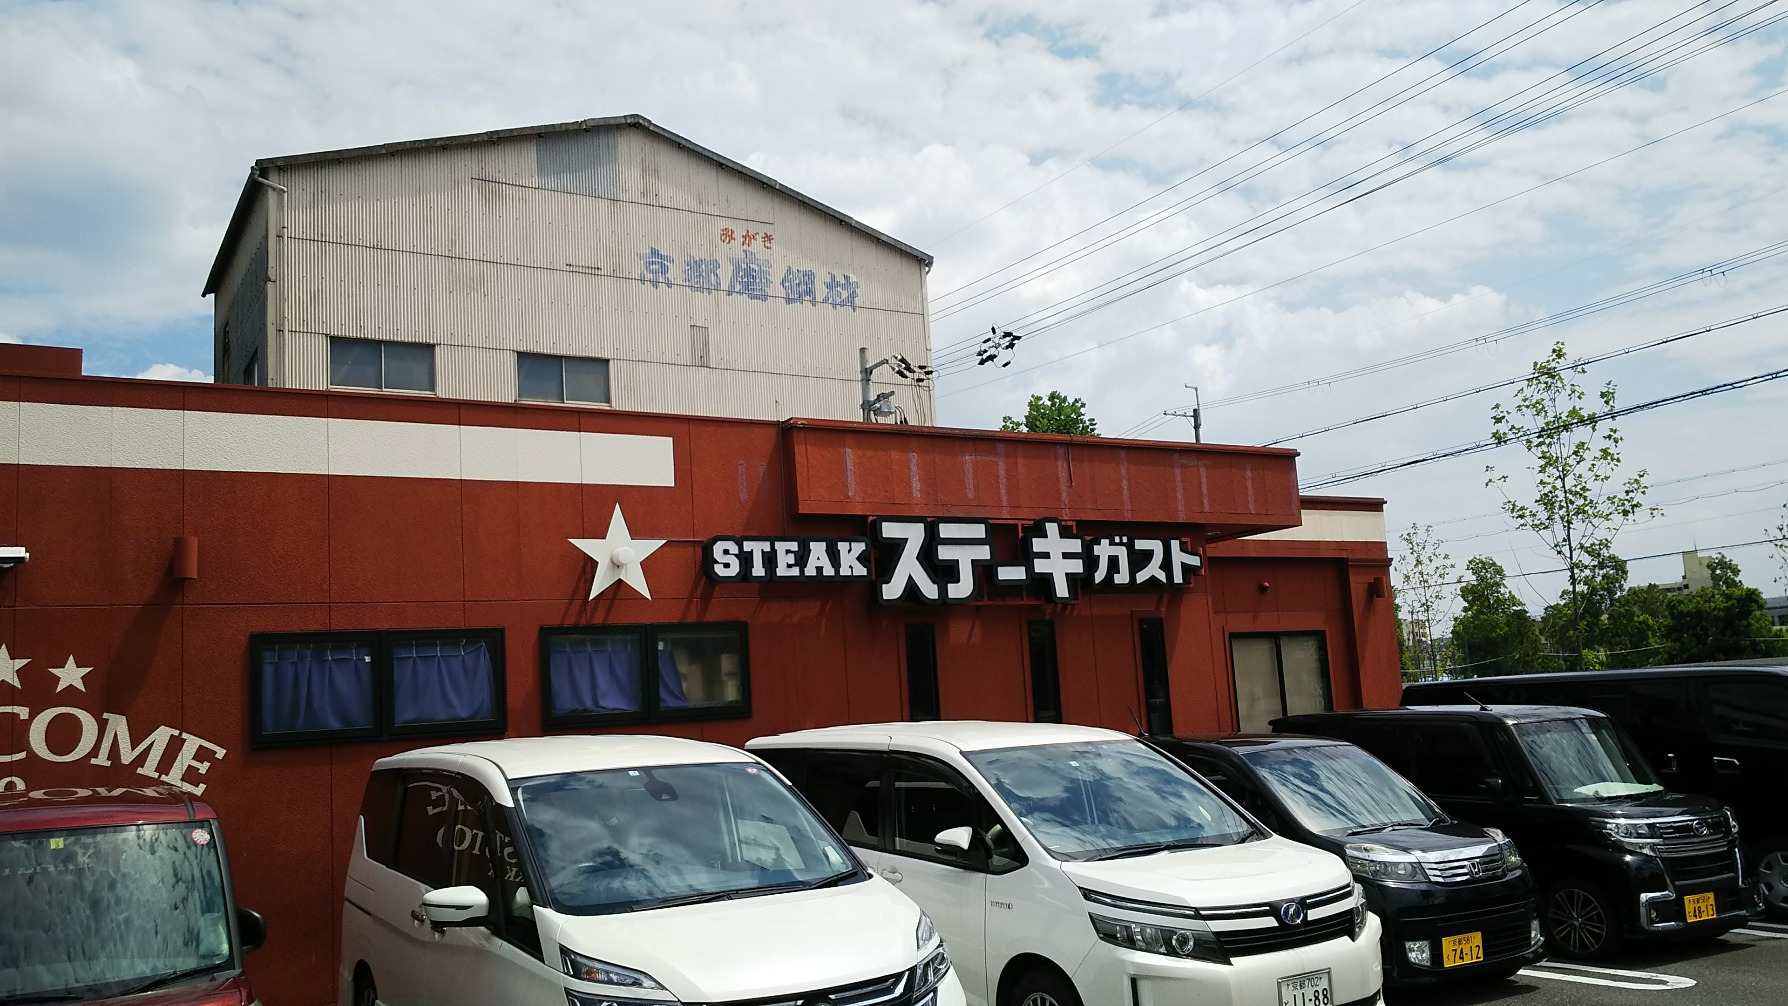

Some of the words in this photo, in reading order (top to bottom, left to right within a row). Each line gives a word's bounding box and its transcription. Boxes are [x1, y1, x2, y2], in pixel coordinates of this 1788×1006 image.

[720, 227, 775, 250] みがき
[636, 246, 861, 312] 京都磨鋼材
[712, 539, 869, 578] STEAK
[1692, 903, 1715, 919] 48-13
[1451, 944, 1482, 964] 74-12
[1293, 987, 1330, 1006] 11-88
